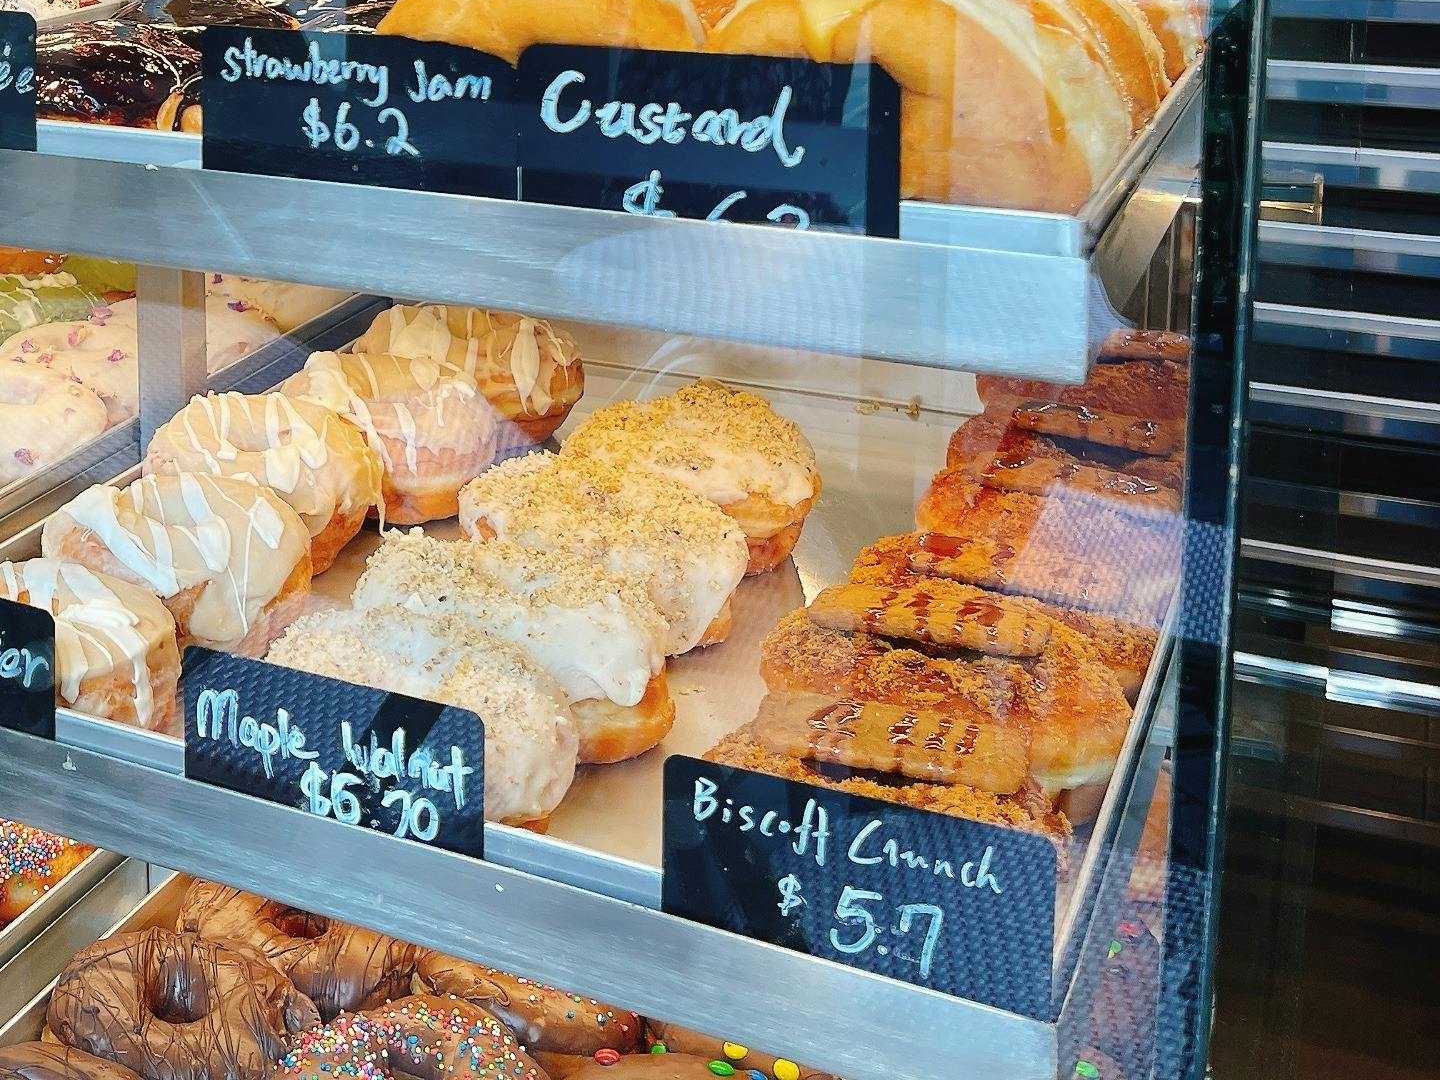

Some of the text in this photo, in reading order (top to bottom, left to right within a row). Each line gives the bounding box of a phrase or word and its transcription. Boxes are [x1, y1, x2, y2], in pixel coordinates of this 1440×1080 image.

[407, 58, 494, 104] Jam
[539, 70, 805, 167] Custard
[302, 97, 422, 157] $6.2
[197, 688, 320, 779] Maple
